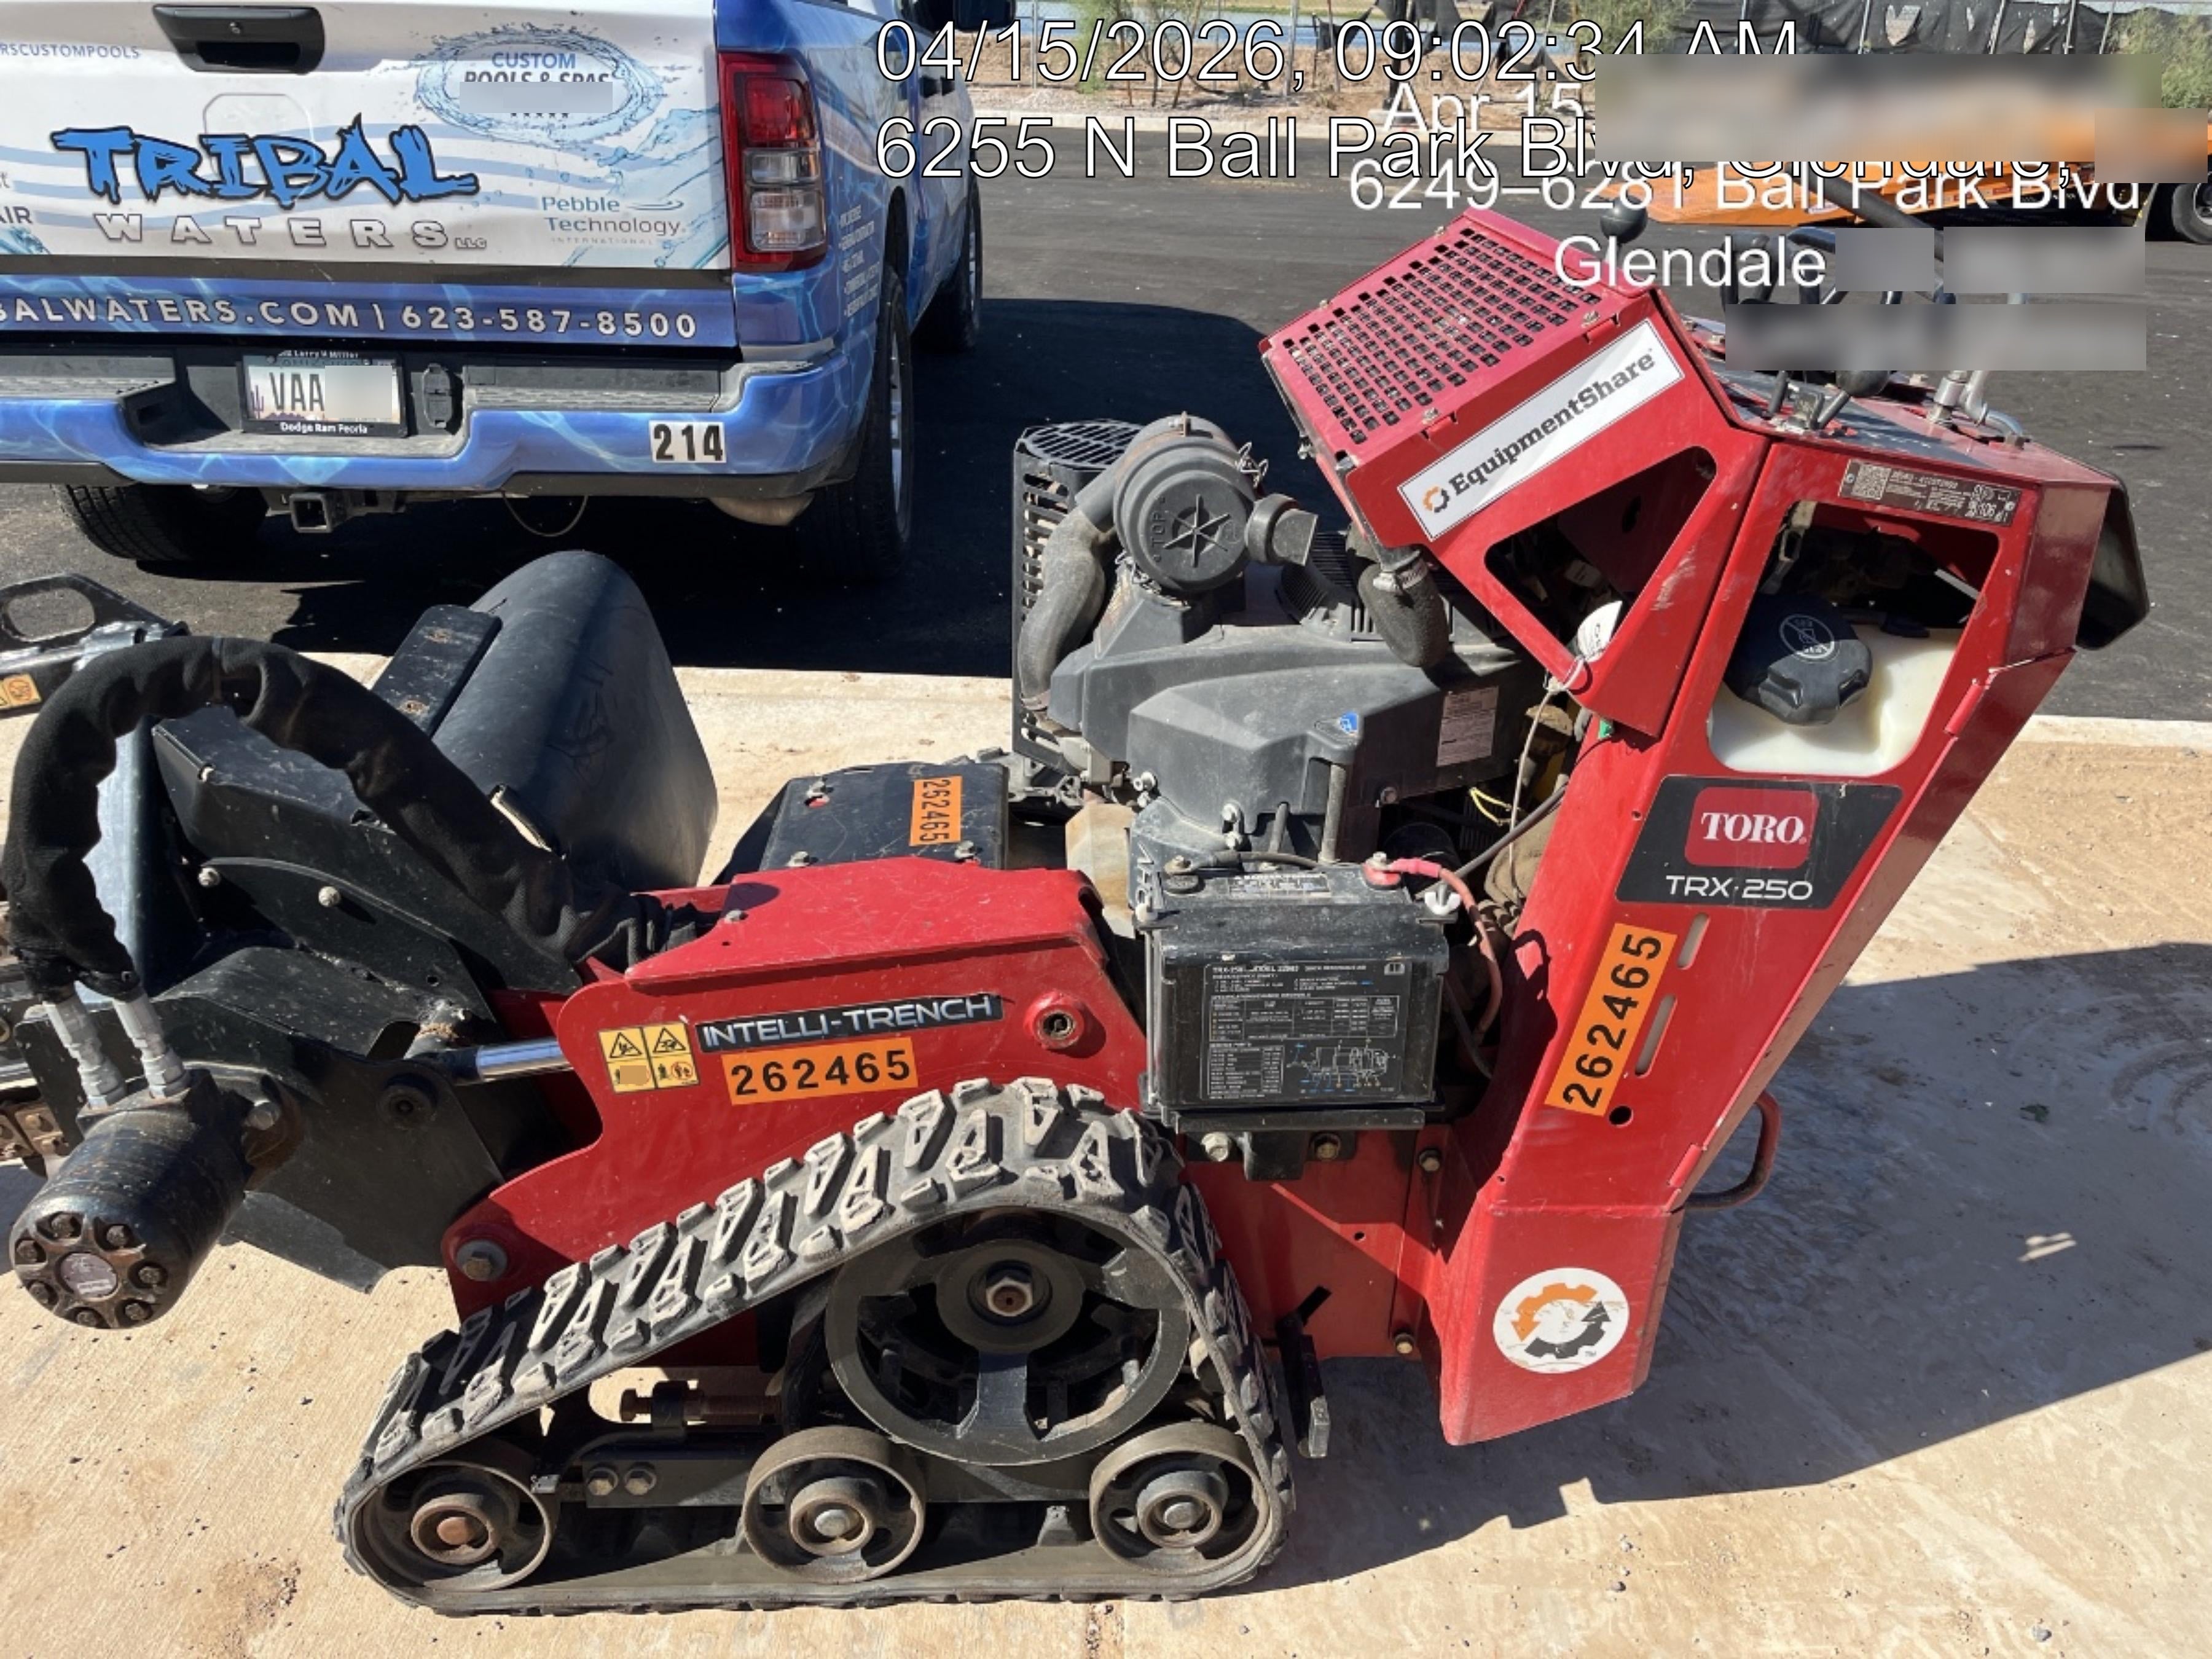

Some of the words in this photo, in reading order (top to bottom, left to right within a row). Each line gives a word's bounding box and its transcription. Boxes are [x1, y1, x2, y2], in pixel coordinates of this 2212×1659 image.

[492, 52, 576, 69] CUSTOM
[50, 113, 479, 210] TRIBAL
[541, 197, 620, 212] Pebble
[93, 213, 448, 248] WATERS
[402, 305, 697, 339] 623-587-8500
[269, 372, 325, 412] VAA
[280, 422, 313, 433] Dodge
[315, 423, 336, 432] Ram
[339, 423, 368, 434] Peoria
[1448, 351, 1656, 495] EquipmentShare
[654, 424, 724, 461] 214
[920, 779, 951, 842] 262465
[1701, 812, 1805, 843] TORO
[703, 995, 992, 1046] INTELLI-TRENCH
[1563, 933, 1661, 1108] 262465
[731, 1049, 911, 1096] 262465
